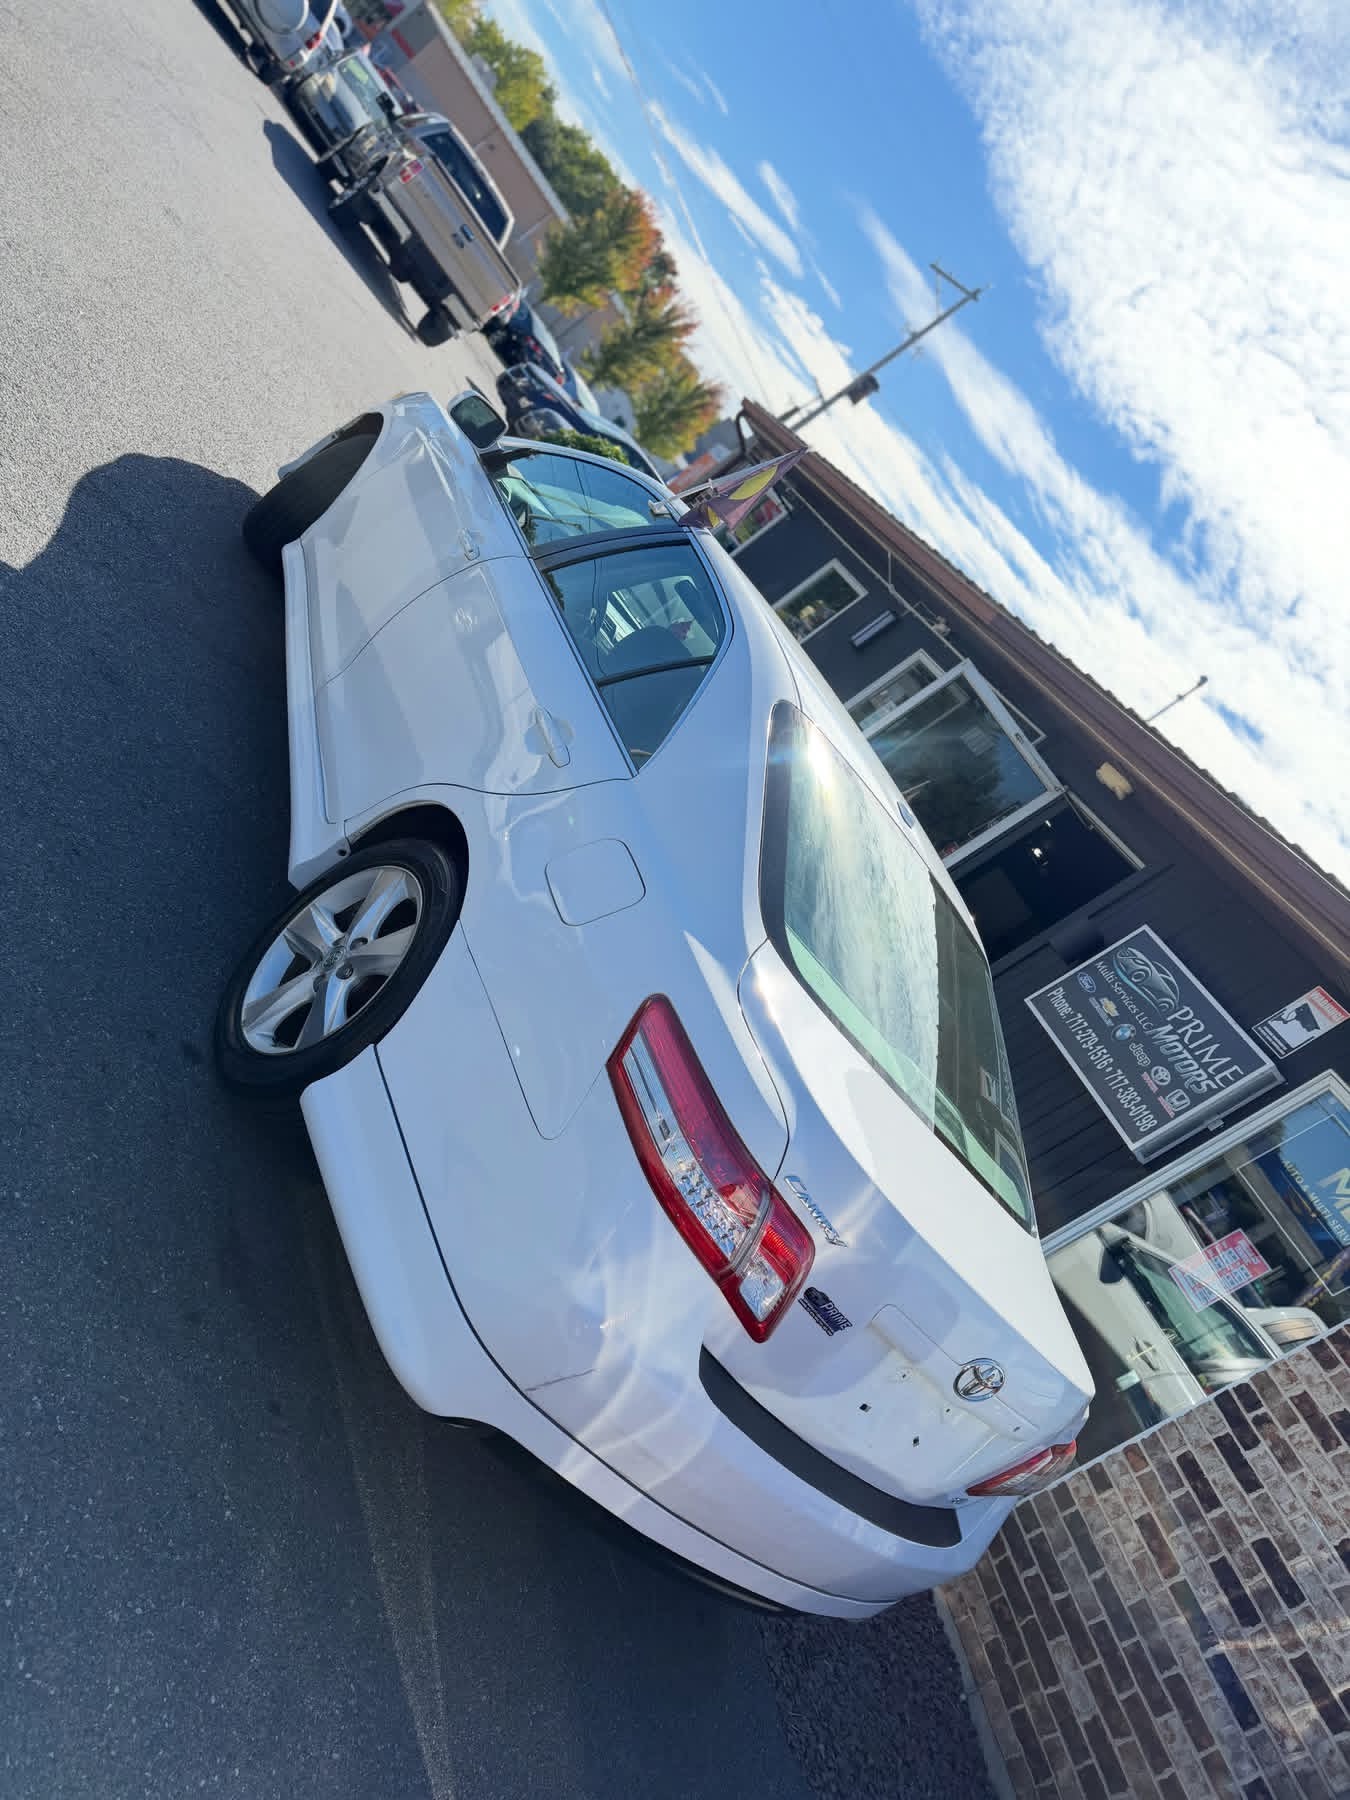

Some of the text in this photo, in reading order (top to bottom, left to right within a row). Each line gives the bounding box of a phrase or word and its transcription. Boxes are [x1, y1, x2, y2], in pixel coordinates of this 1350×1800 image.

[1078, 973, 1096, 991] Ford
[1095, 960, 1118, 985] Multi
[1111, 982, 1141, 1015] Services
[1135, 1011, 1154, 1031] LLC
[1047, 986, 1074, 1019] Phone:
[1065, 1012, 1115, 1070] 717-279-1516
[1104, 1068, 1158, 1132] 717-383-0198
[1129, 1042, 1151, 1067] Jeep
[1144, 1023, 1218, 1095] MOTORS
[1166, 1005, 1244, 1088] PRIME
[784, 1175, 848, 1248] CAMRY
[1282, 1159, 1305, 1185] AUTO
[1308, 1191, 1333, 1219] MULTI
[820, 1301, 853, 1332] PRIME
